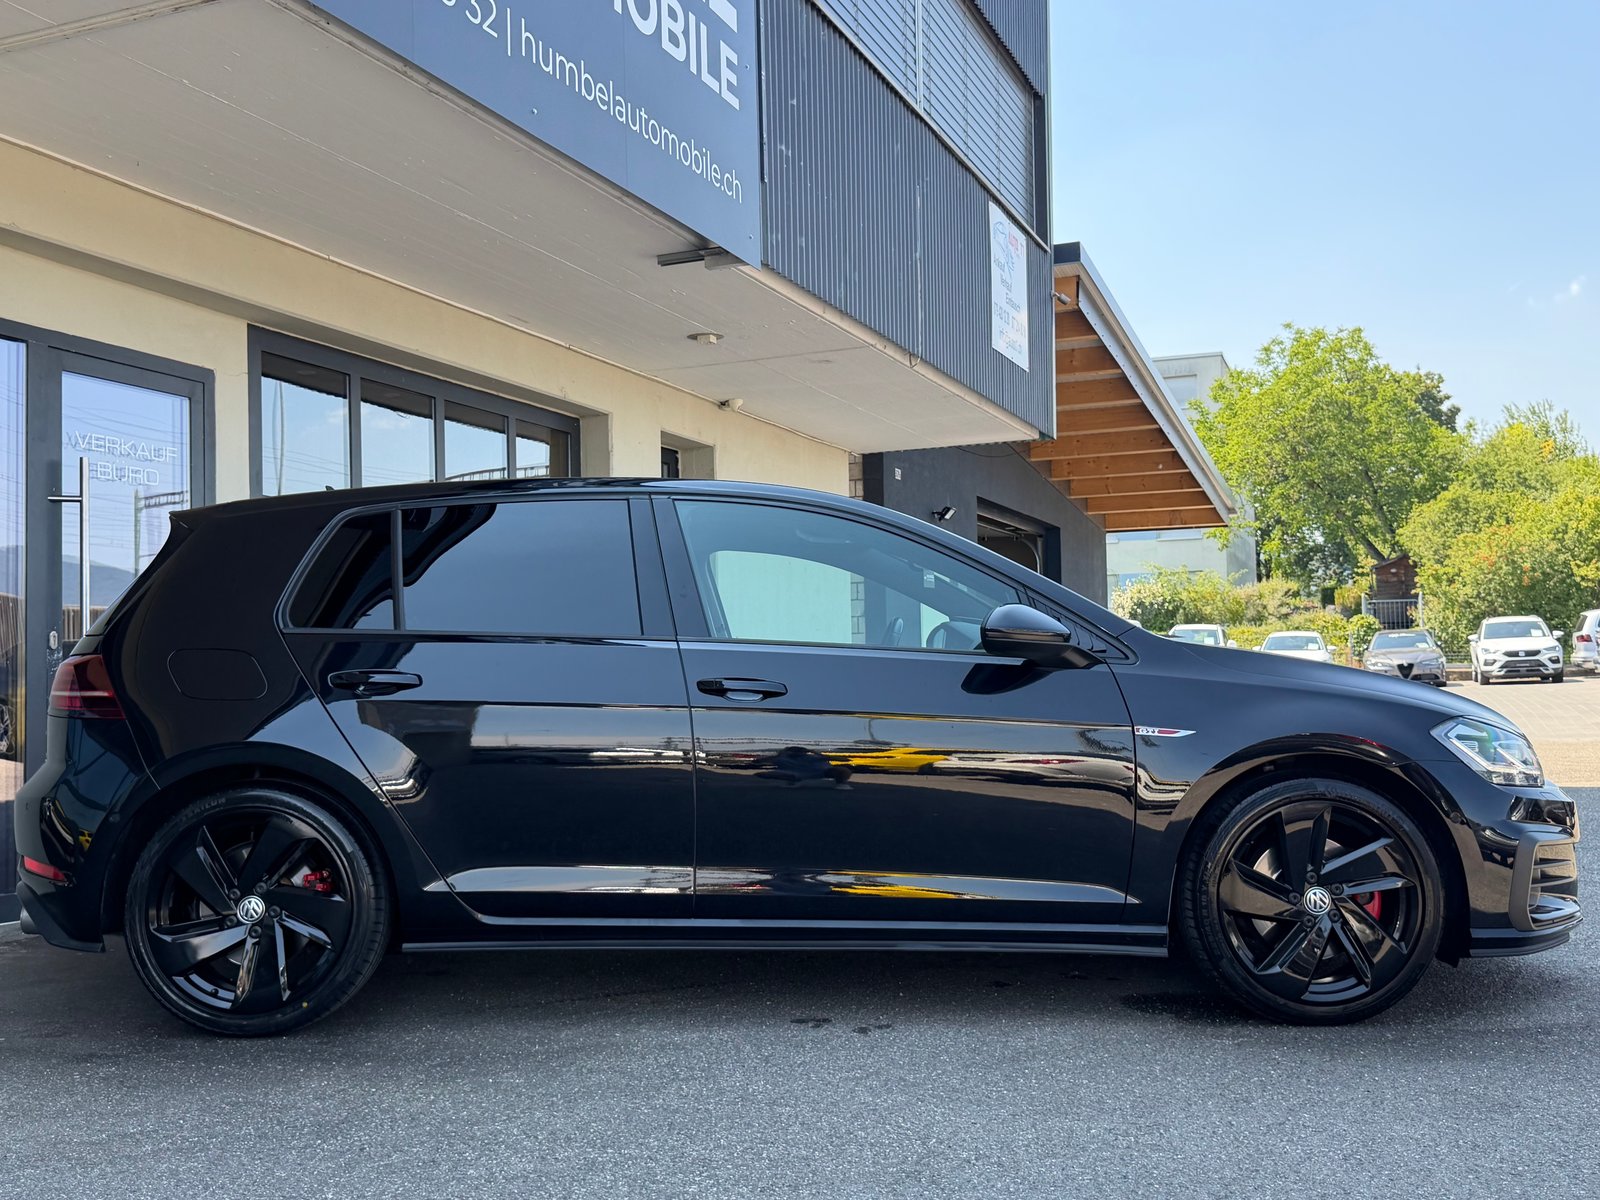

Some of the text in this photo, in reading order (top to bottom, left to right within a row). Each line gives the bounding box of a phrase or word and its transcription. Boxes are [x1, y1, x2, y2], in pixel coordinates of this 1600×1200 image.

[614, 0, 740, 111] OBILE
[521, 17, 743, 204] humbelautomobile.ch
[75, 430, 178, 463] VERKAUF
[96, 459, 160, 486] BÜRO
